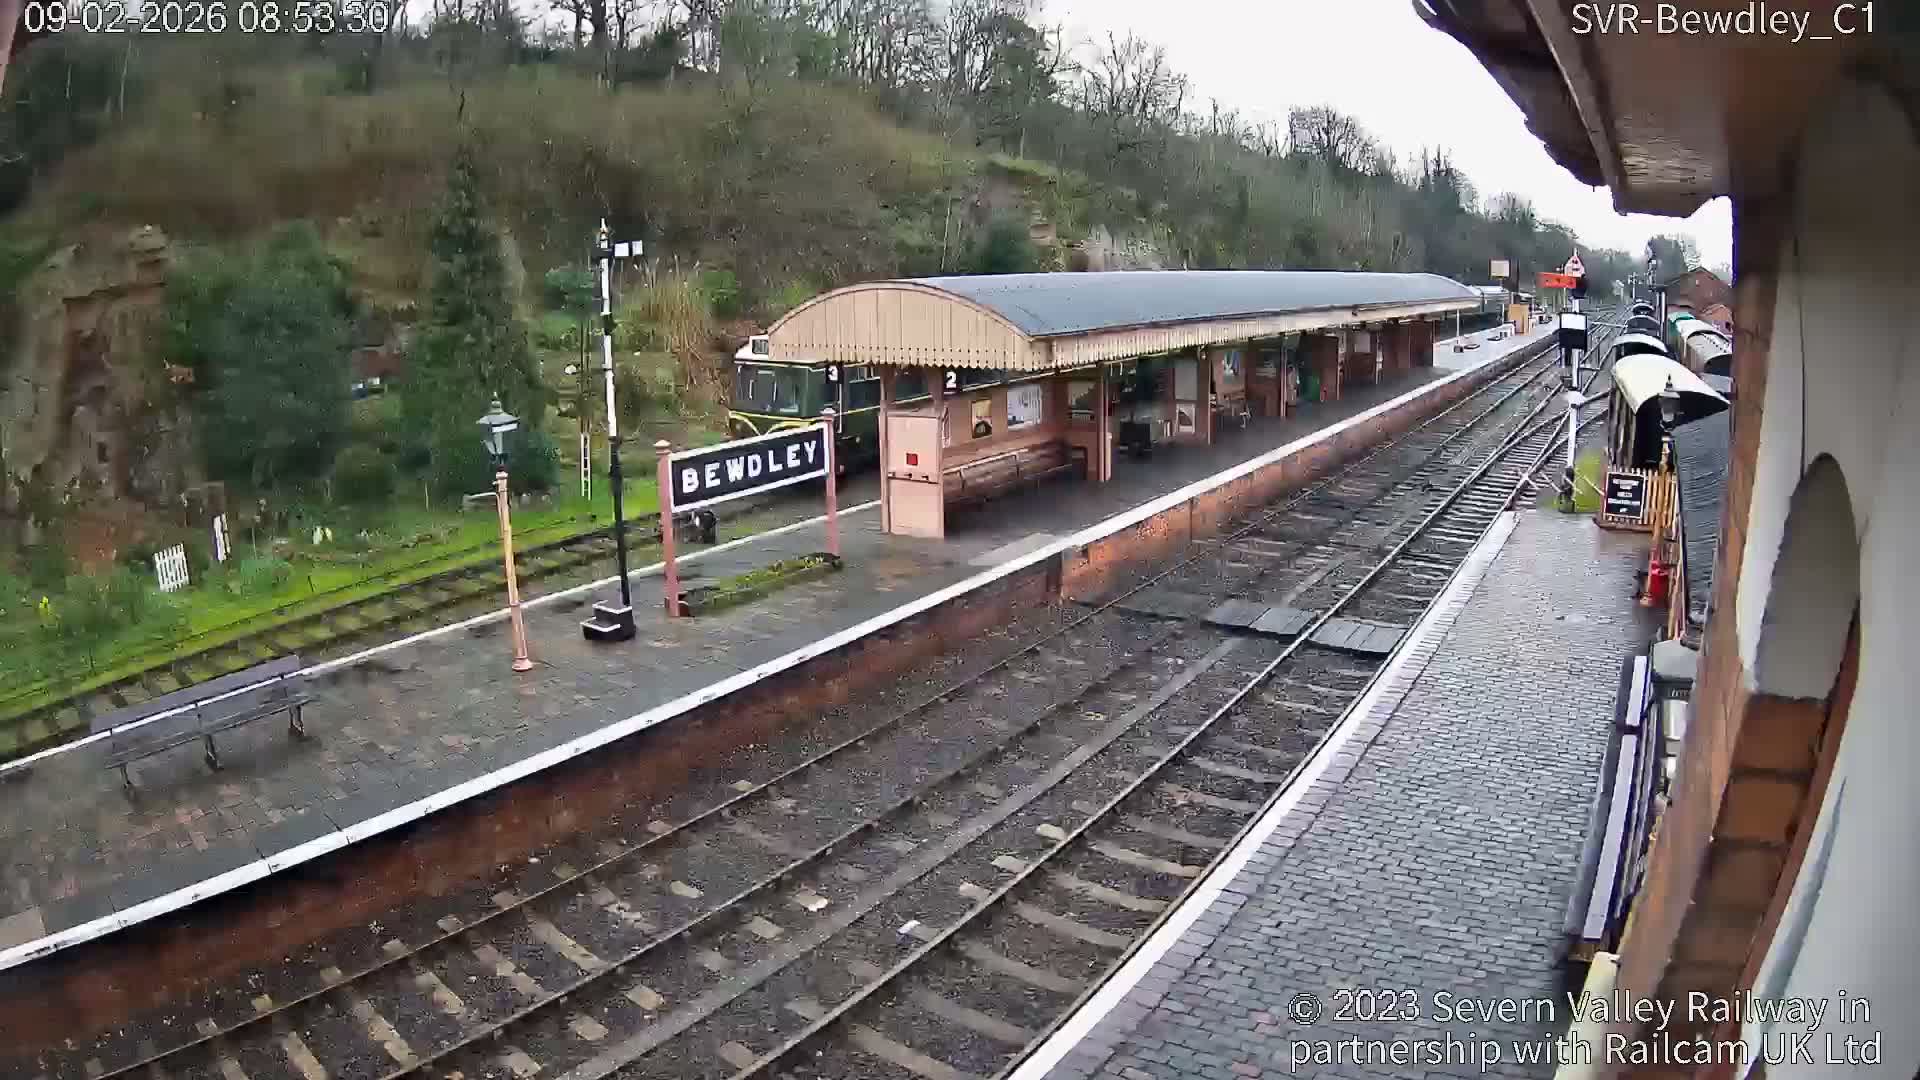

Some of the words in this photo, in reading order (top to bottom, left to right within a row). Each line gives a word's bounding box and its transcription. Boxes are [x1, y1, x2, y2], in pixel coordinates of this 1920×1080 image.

[827, 365, 839, 381] 3
[946, 371, 957, 389] 2
[681, 440, 817, 494] BEWDLEY
